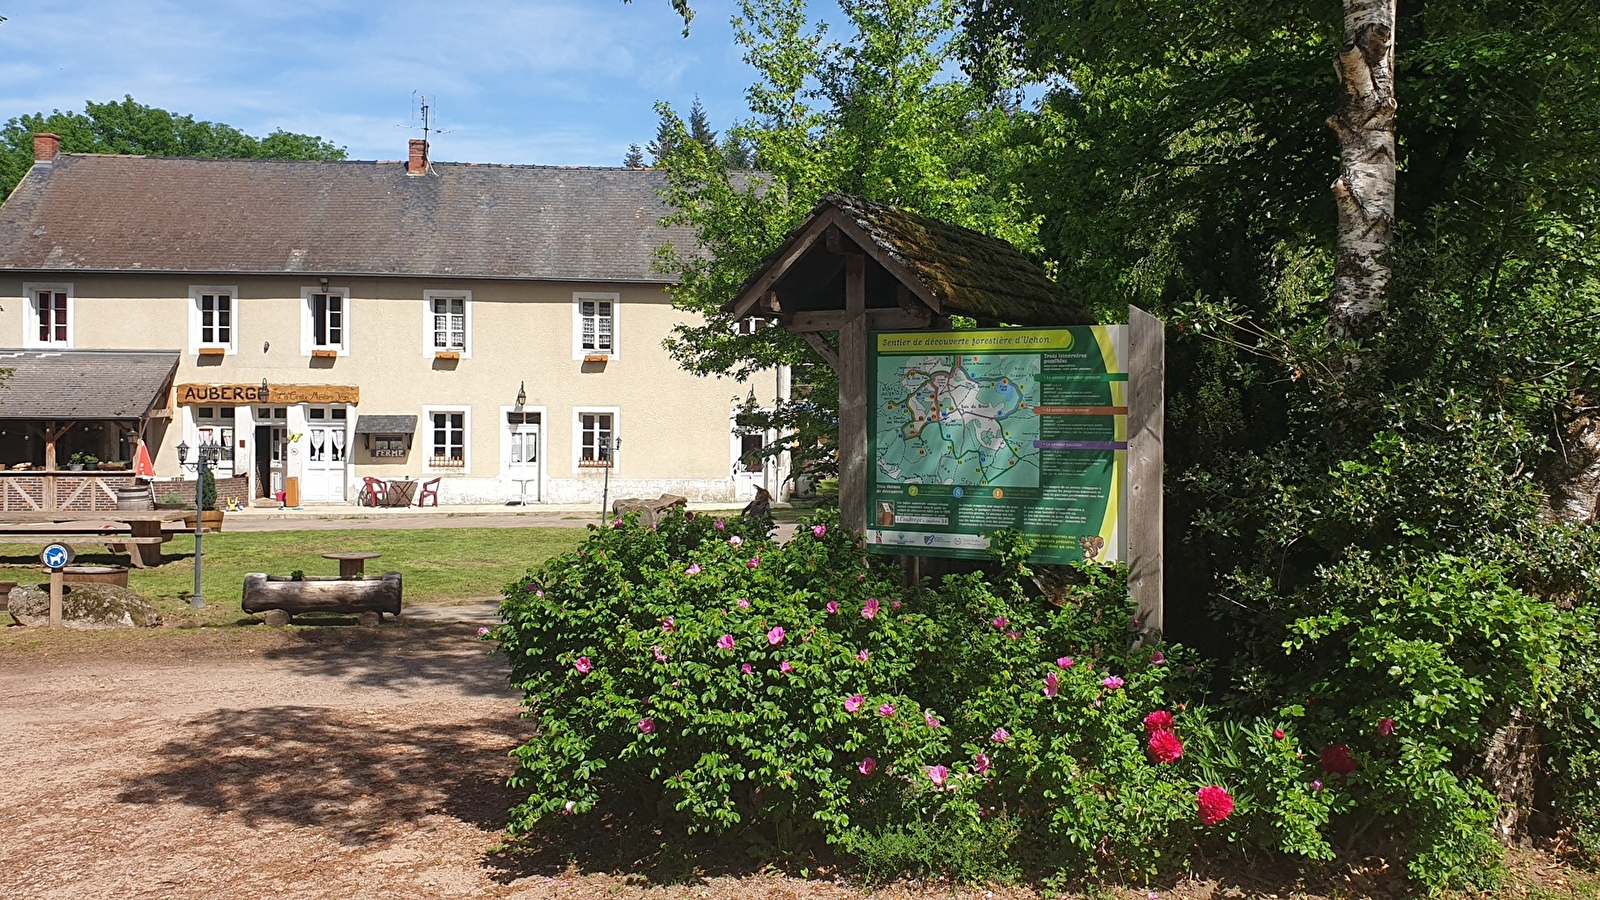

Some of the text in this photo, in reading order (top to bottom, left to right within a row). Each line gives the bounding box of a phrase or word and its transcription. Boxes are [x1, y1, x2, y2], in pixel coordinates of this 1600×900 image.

[882, 335, 1050, 347] Sentier de découverte forestière d'Uchon
